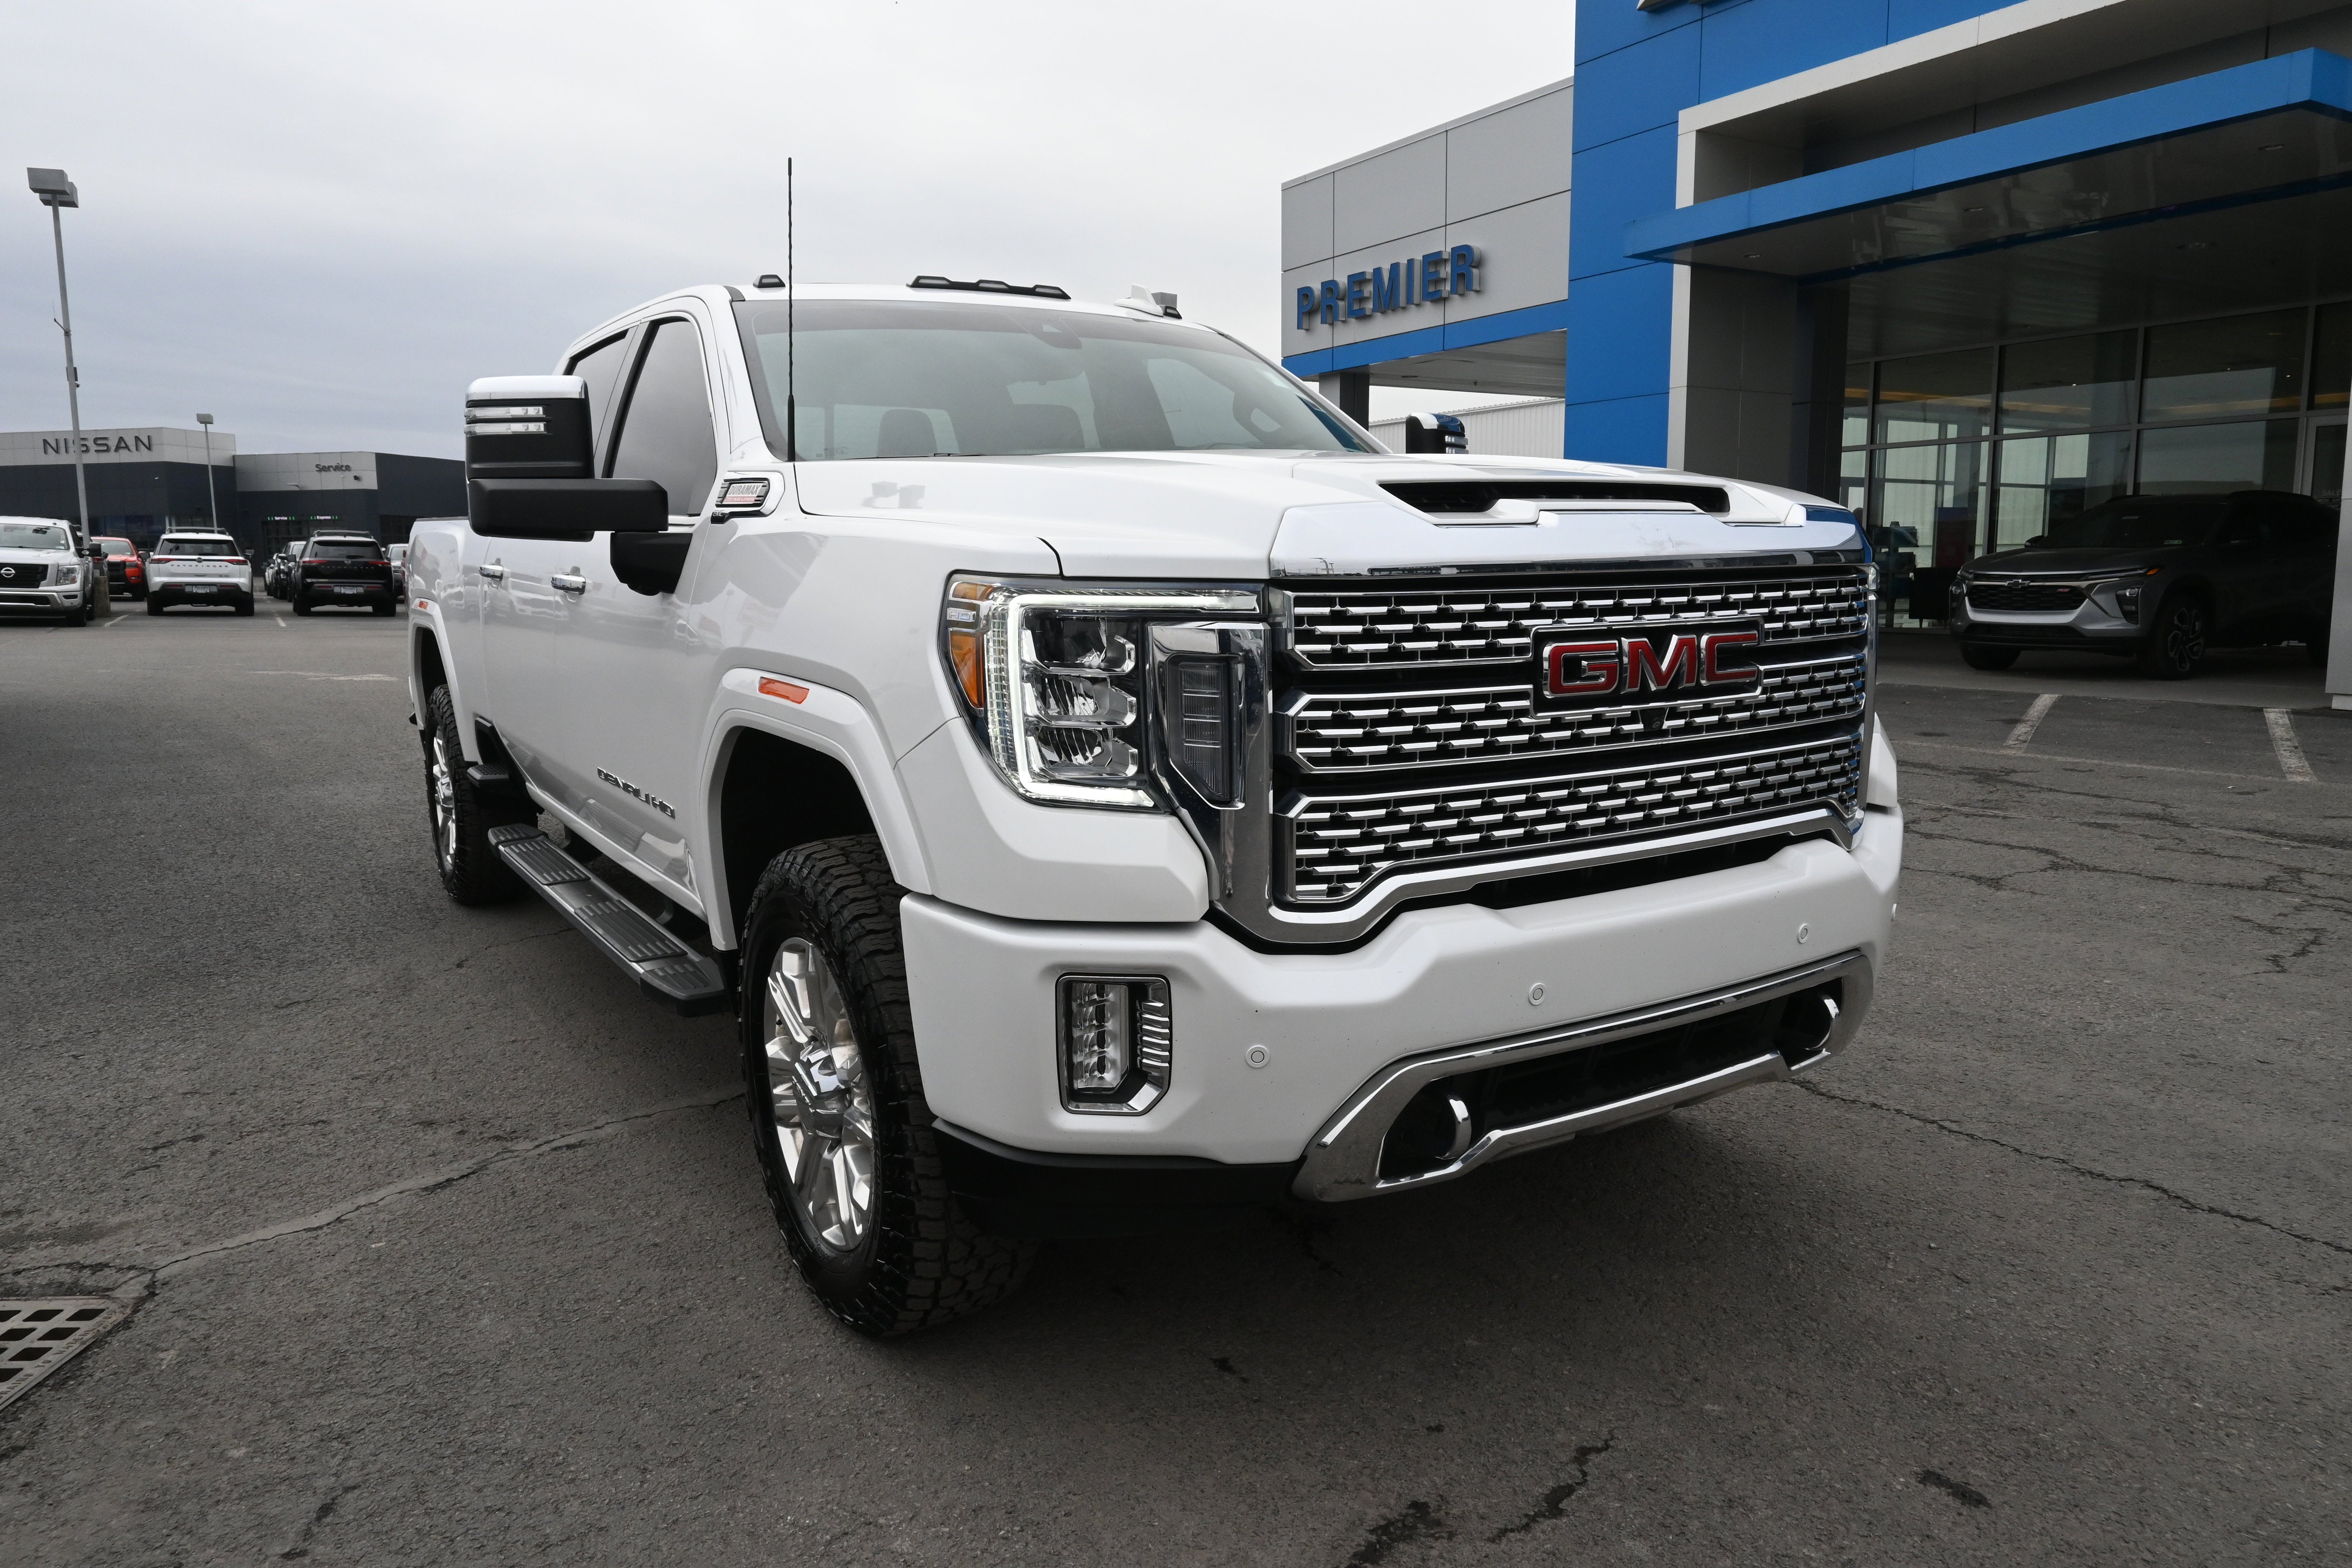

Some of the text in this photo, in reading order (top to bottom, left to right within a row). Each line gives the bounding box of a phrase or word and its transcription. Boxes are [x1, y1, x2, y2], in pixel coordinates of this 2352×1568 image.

[1297, 244, 1481, 331] PREMIER
[42, 435, 152, 455] NISSAN
[315, 463, 351, 472] Service
[729, 485, 761, 495] DURAMAX
[1542, 629, 1759, 699] GMC
[597, 767, 676, 819] DENALI HD
[0, 1373, 34, 1399] RAINS
